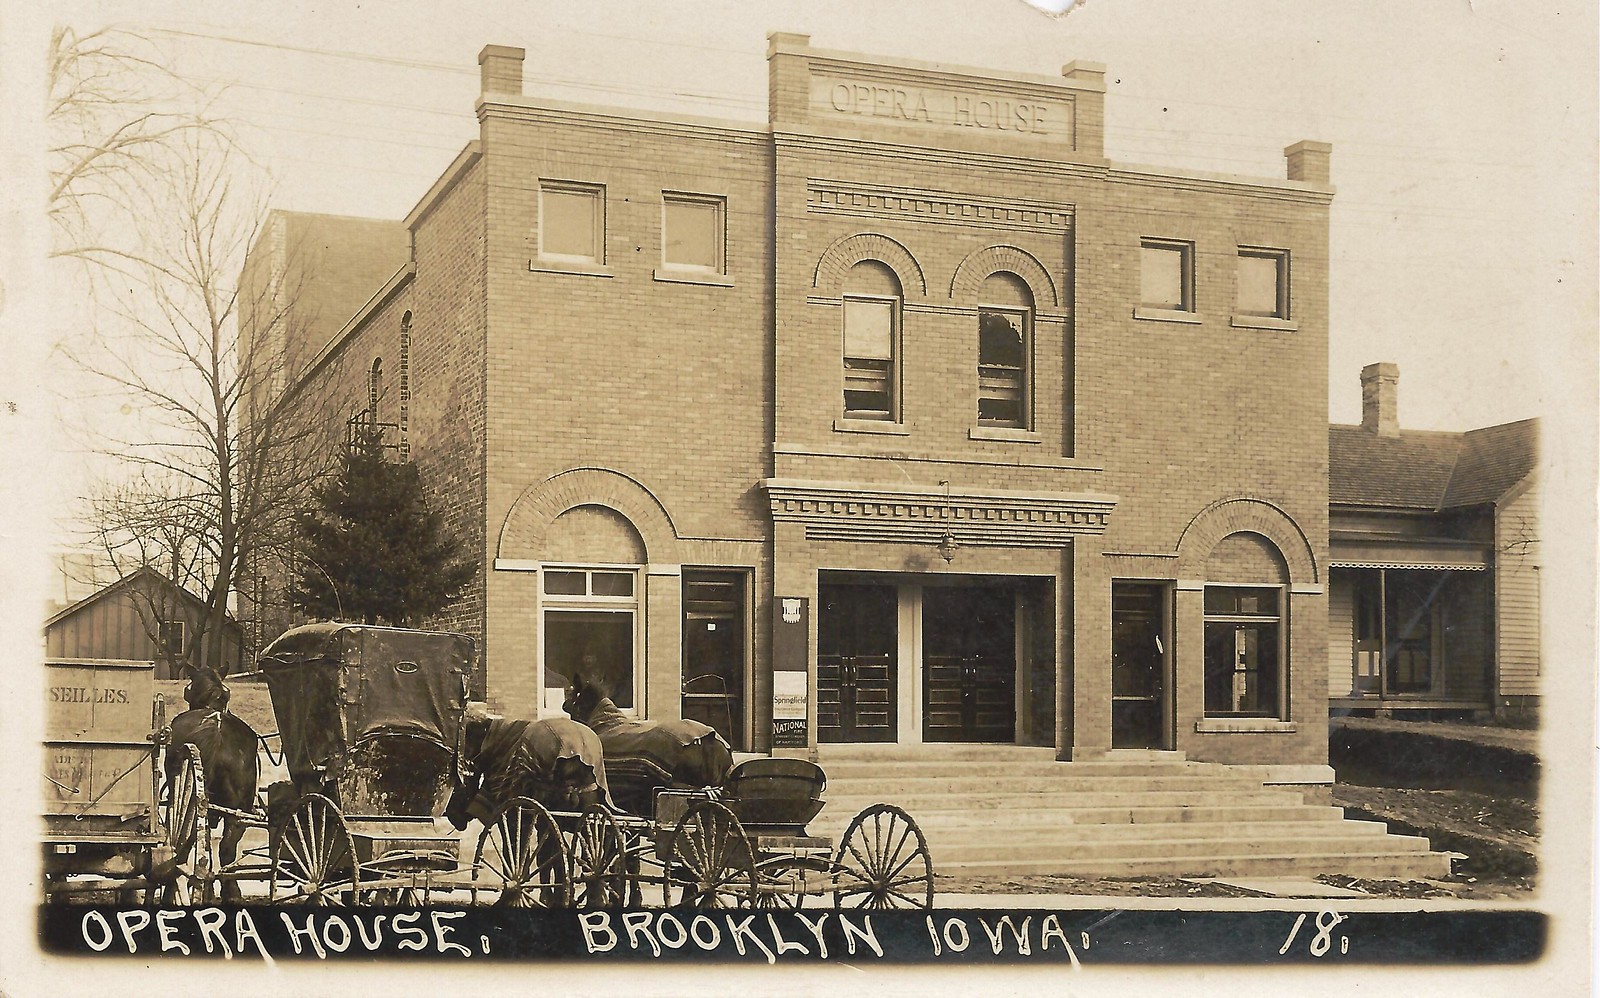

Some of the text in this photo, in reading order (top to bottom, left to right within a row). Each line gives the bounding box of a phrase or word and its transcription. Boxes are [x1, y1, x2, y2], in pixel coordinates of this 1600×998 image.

[830, 83, 1049, 136] OPERA HOUSE
[774, 696, 807, 705] Springfield
[773, 721, 807, 735] NATIONAL
